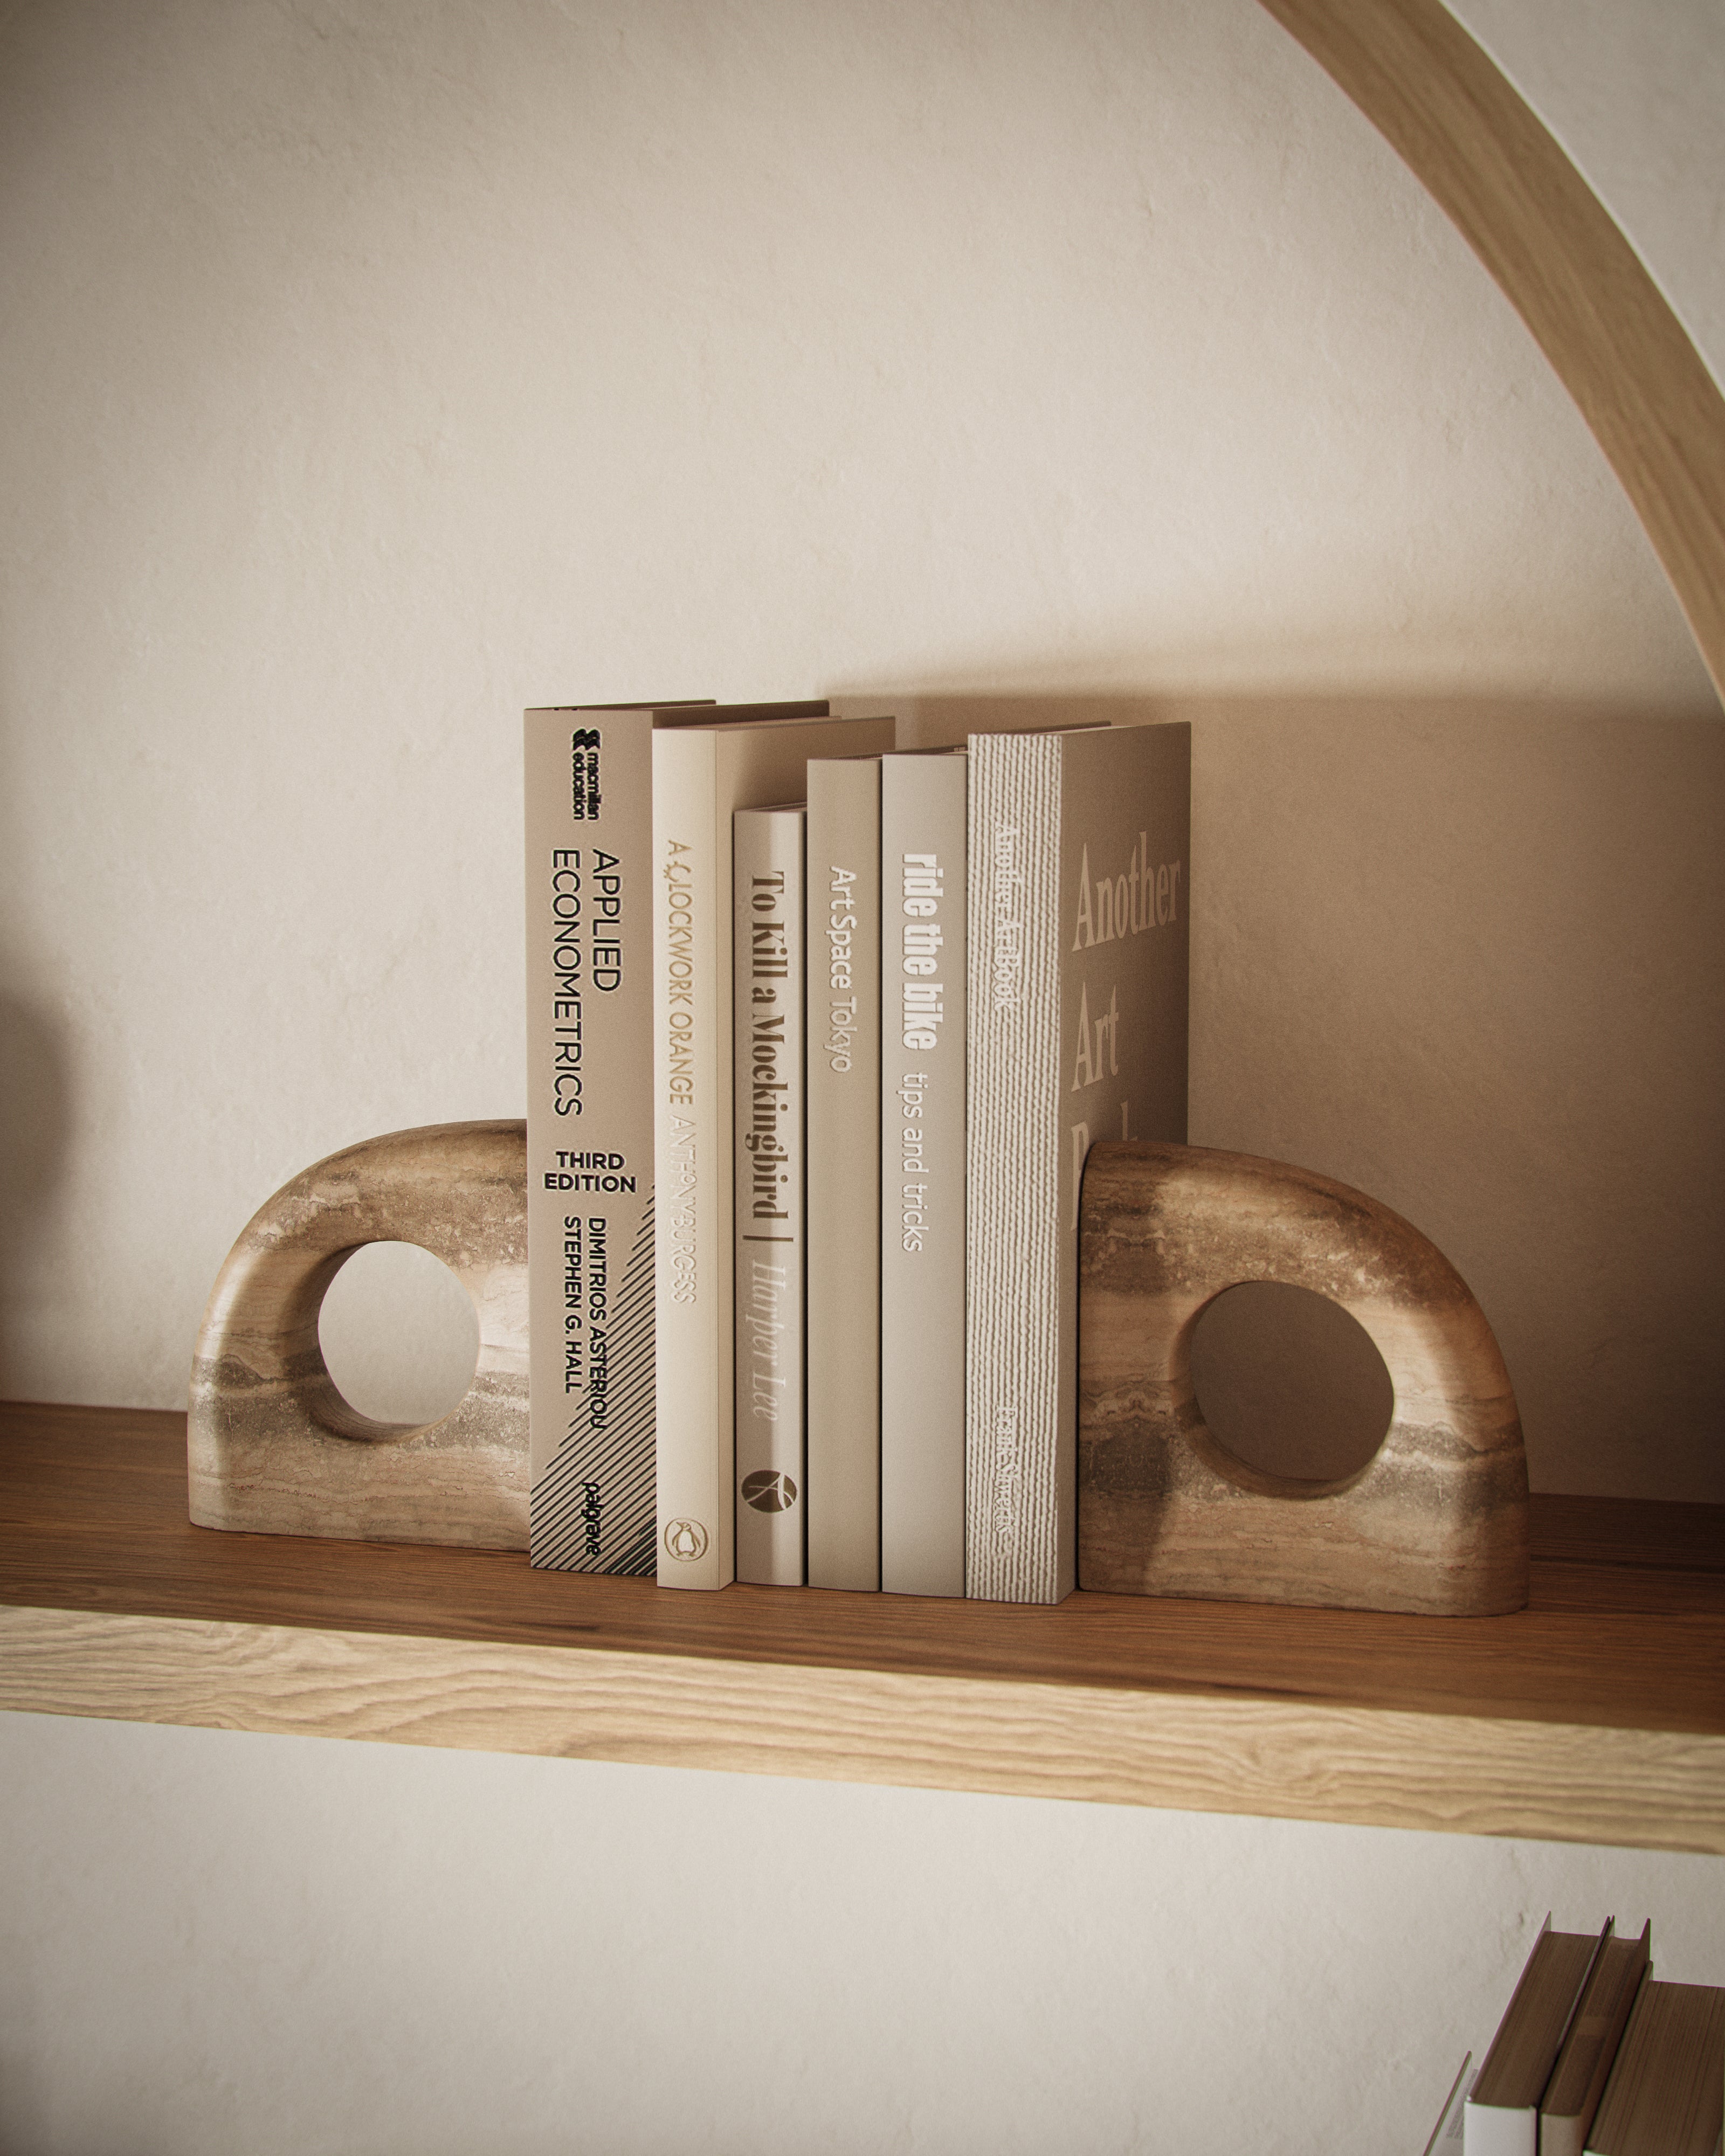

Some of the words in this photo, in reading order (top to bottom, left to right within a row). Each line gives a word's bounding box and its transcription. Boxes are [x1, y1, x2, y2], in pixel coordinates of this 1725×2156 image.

[572, 752, 586, 820] education
[586, 752, 602, 820] macmillan
[668, 839, 693, 856] A
[995, 822, 1022, 911] Another
[593, 848, 621, 992] APPLIED
[752, 870, 784, 912] To
[902, 853, 944, 917] ride
[1072, 831, 1181, 952] Another
[664, 861, 693, 1005] CLOCKWORK
[752, 922, 788, 978] Kill
[902, 923, 944, 976] the
[553, 849, 582, 1116] ECONOMETRICS
[751, 987, 776, 1003] a
[902, 983, 944, 1051] bike
[669, 1011, 693, 1104] ORANGE
[823, 996, 858, 1074] Tokyo
[1071, 981, 1119, 1092] Art
[746, 1014, 789, 1219] Mockingbird
[896, 1072, 929, 1119] tips
[544, 1172, 636, 1193] EDITION
[556, 1151, 625, 1170] THIRD
[671, 1115, 698, 1215] ANTHONY
[902, 1127, 930, 1173] and
[901, 1183, 930, 1253] tricks
[564, 1215, 582, 1308] STEPHEN
[589, 1218, 607, 1321] DIMITRIOS
[672, 1215, 698, 1303] BURGESS
[565, 1314, 582, 1335] G.
[746, 1259, 786, 1367] Harper
[565, 1341, 583, 1394] HALL
[589, 1326, 608, 1429] ASTERIOU
[753, 1371, 786, 1422] Lee
[581, 1482, 604, 1556] palgrave
